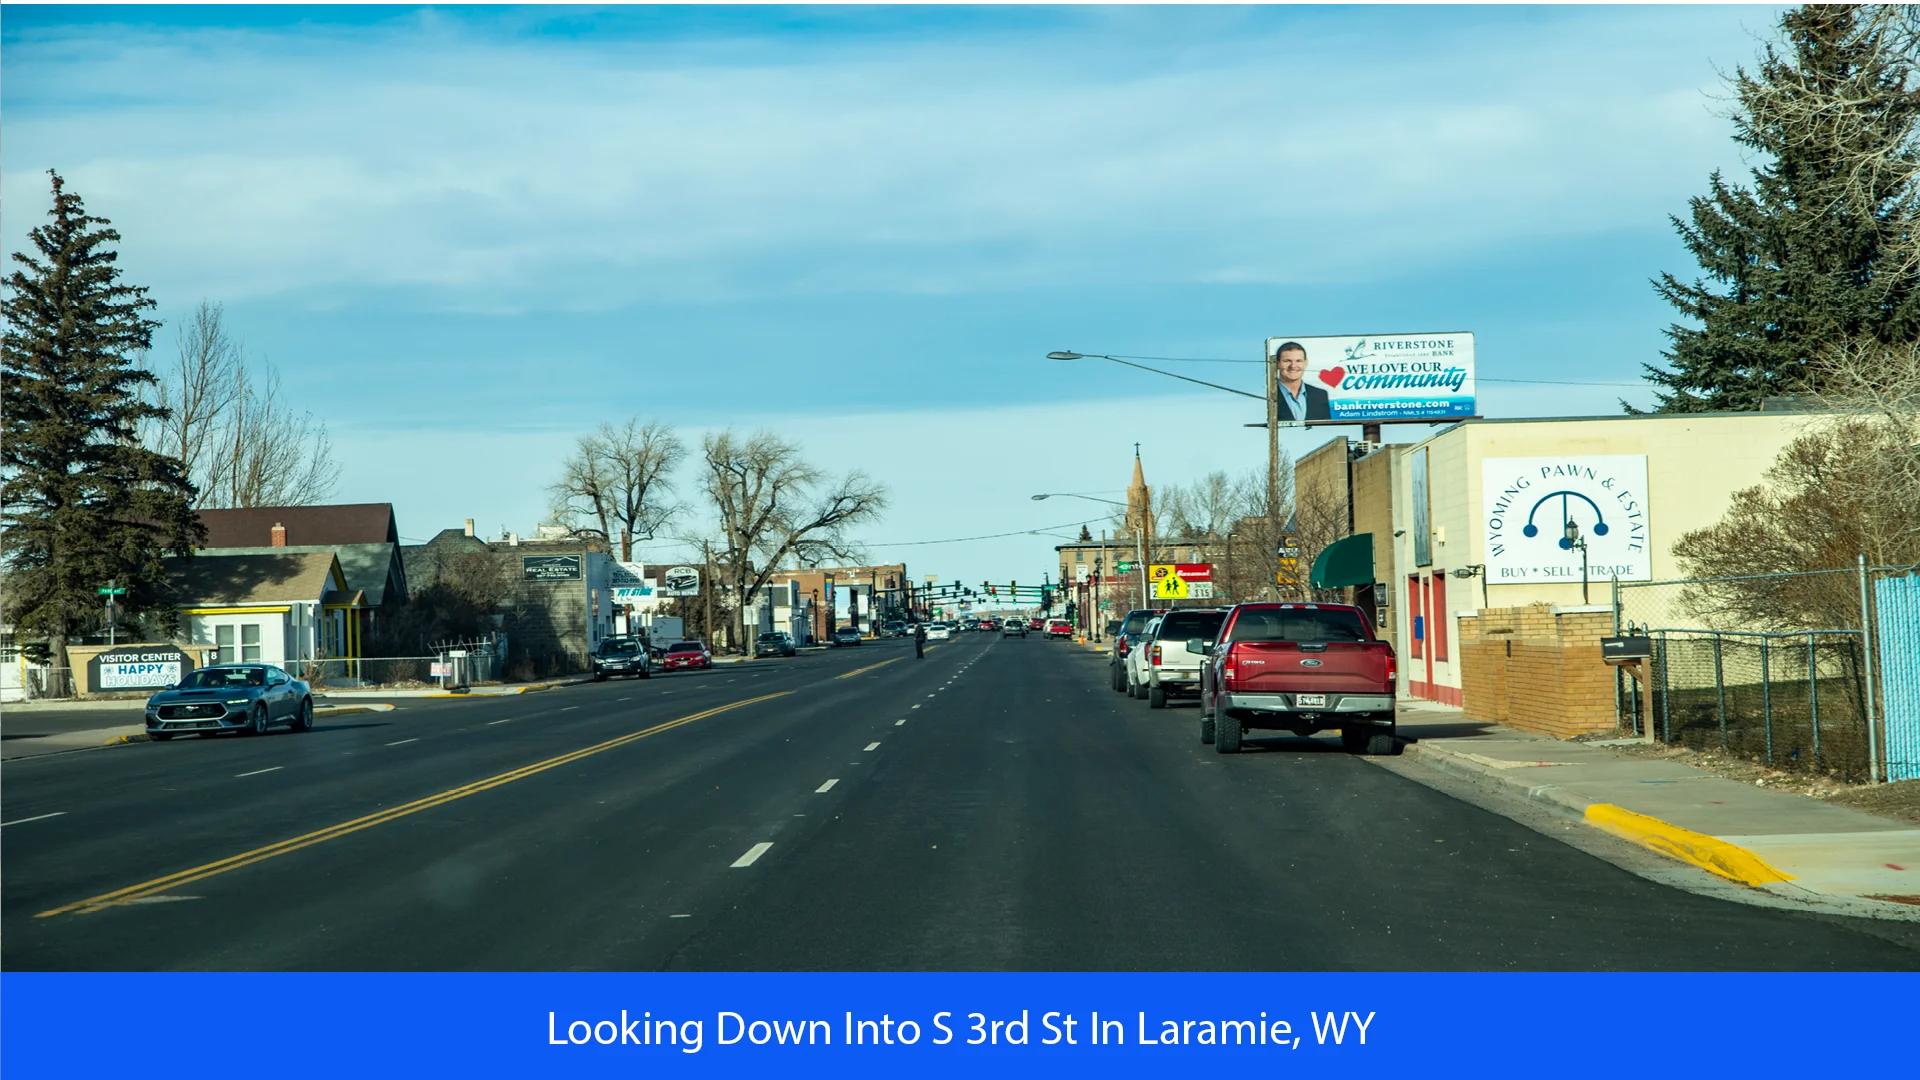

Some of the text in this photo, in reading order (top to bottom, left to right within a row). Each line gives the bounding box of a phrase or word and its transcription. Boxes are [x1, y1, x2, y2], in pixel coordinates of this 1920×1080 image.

[1374, 340, 1454, 351] RIVERSTONE
[1346, 362, 1441, 374] WE LOVE OUR
[1341, 366, 1467, 392] community
[1334, 400, 1450, 411] bankriverstone.com
[1489, 464, 1645, 557] WYOMING PAWN & ESTATE
[1501, 567, 1529, 578] BUY
[1543, 566, 1573, 576] SELL
[1589, 565, 1634, 576] TRADE
[99, 652, 181, 663] VISITOR CENTER
[118, 664, 163, 675] HAPPY
[105, 675, 177, 687] HOLIDAYS
